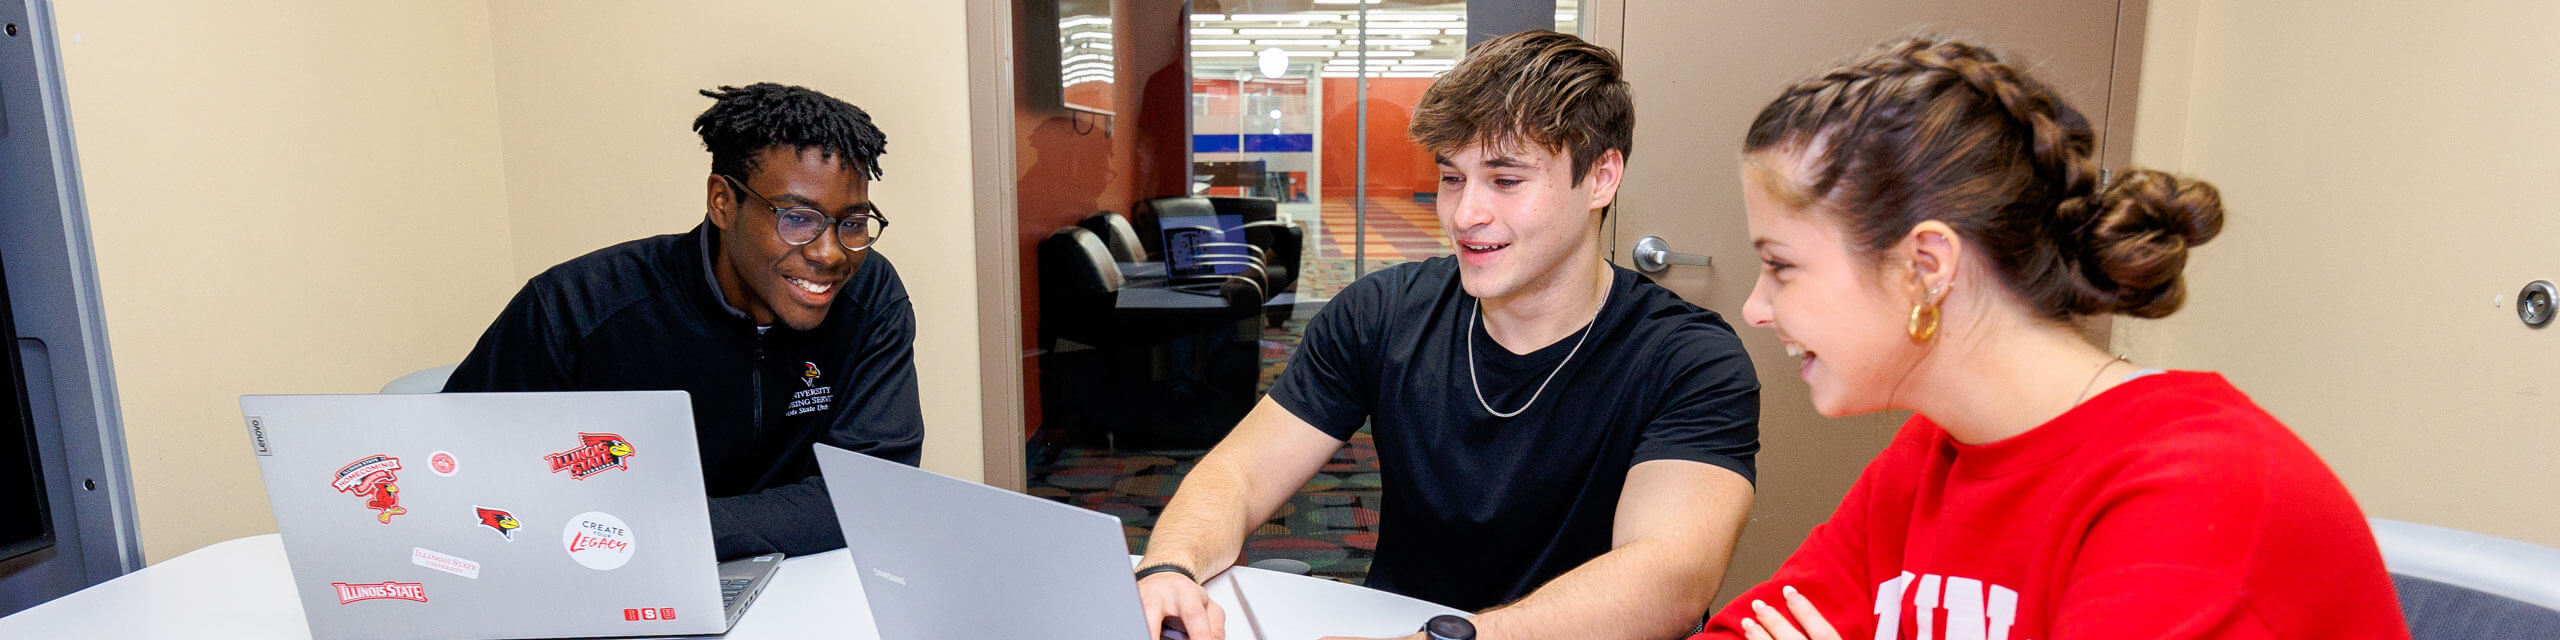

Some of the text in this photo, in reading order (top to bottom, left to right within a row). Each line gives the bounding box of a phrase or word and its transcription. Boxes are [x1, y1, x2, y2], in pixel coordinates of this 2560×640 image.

[791, 386, 831, 400] NIVERSITY
[252, 419, 268, 452] Lenovo
[550, 441, 610, 470] ILLINOIS
[570, 453, 613, 477] STATE
[337, 460, 395, 488] HOMECOMING
[582, 520, 625, 537] CREATE
[569, 531, 629, 553] LEGACY
[415, 548, 478, 571] ILLINOIS STATE
[340, 584, 423, 601] ILLINOIS STATE
